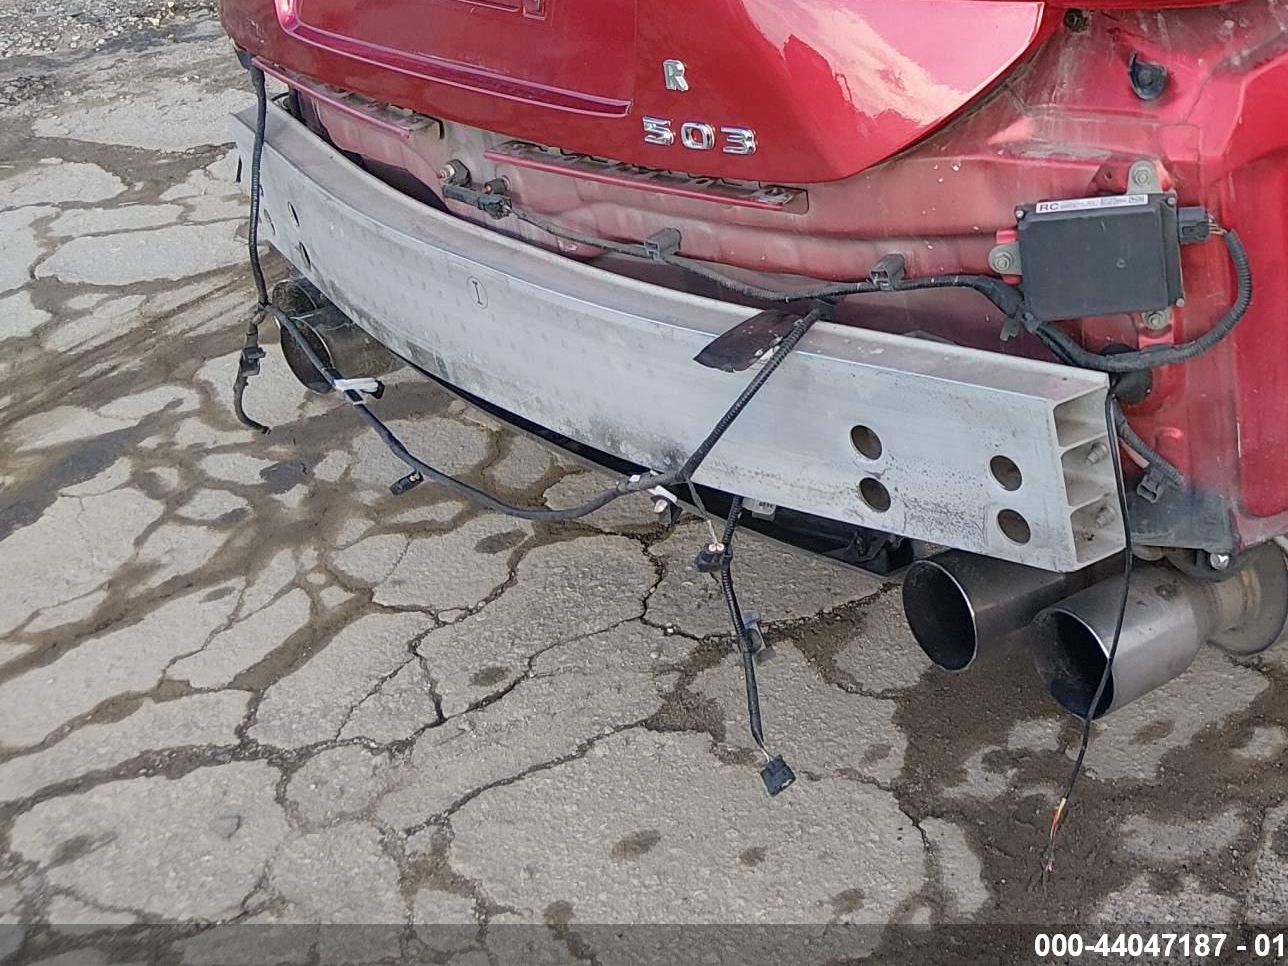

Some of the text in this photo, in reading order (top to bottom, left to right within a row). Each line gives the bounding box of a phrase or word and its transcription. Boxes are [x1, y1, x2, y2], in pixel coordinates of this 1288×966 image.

[662, 58, 689, 91] R
[642, 115, 758, 155] 503
[1039, 203, 1059, 212] RC
